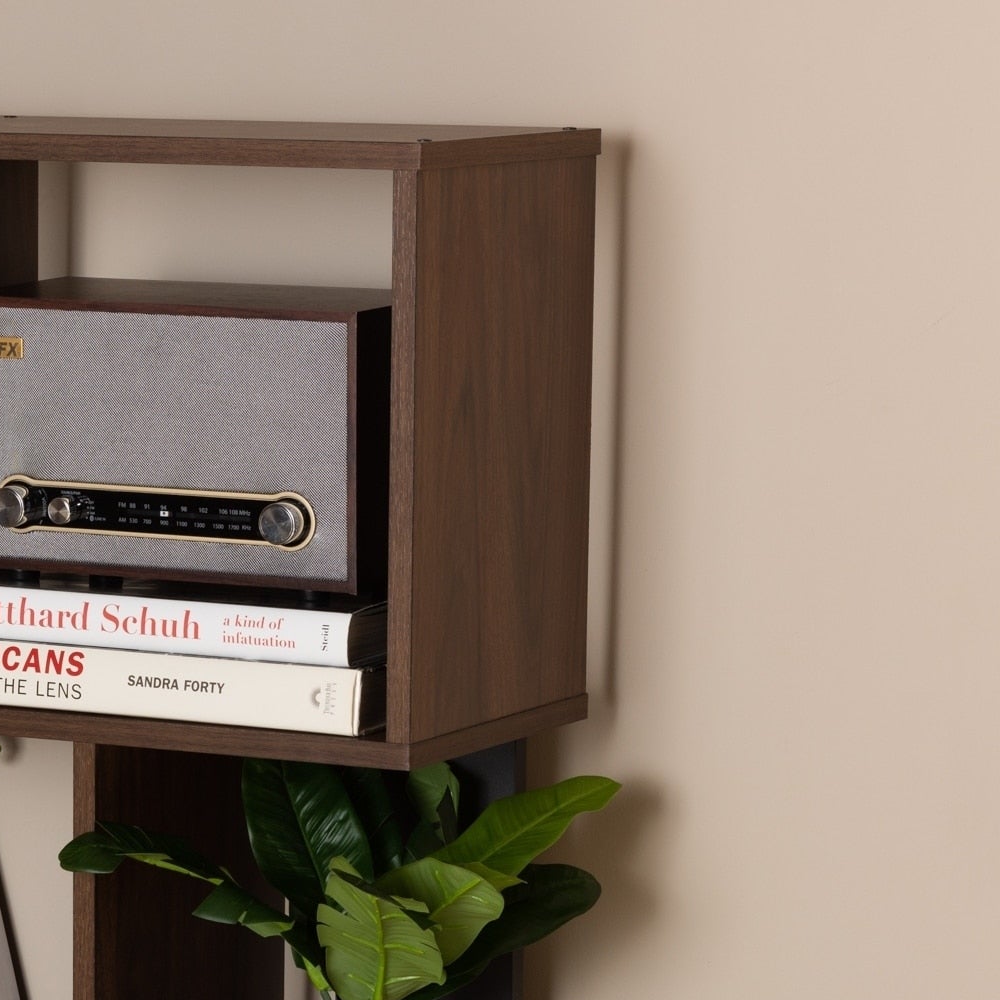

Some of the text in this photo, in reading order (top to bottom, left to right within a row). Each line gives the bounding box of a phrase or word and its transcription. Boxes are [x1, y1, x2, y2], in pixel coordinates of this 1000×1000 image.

[100, 603, 200, 640] Schuh
[223, 614, 285, 631] a kind of
[222, 630, 297, 650] infatuation
[321, 624, 330, 652] Steidl
[36, 680, 83, 700] LENS
[127, 675, 225, 694] SANDRA FORTY
